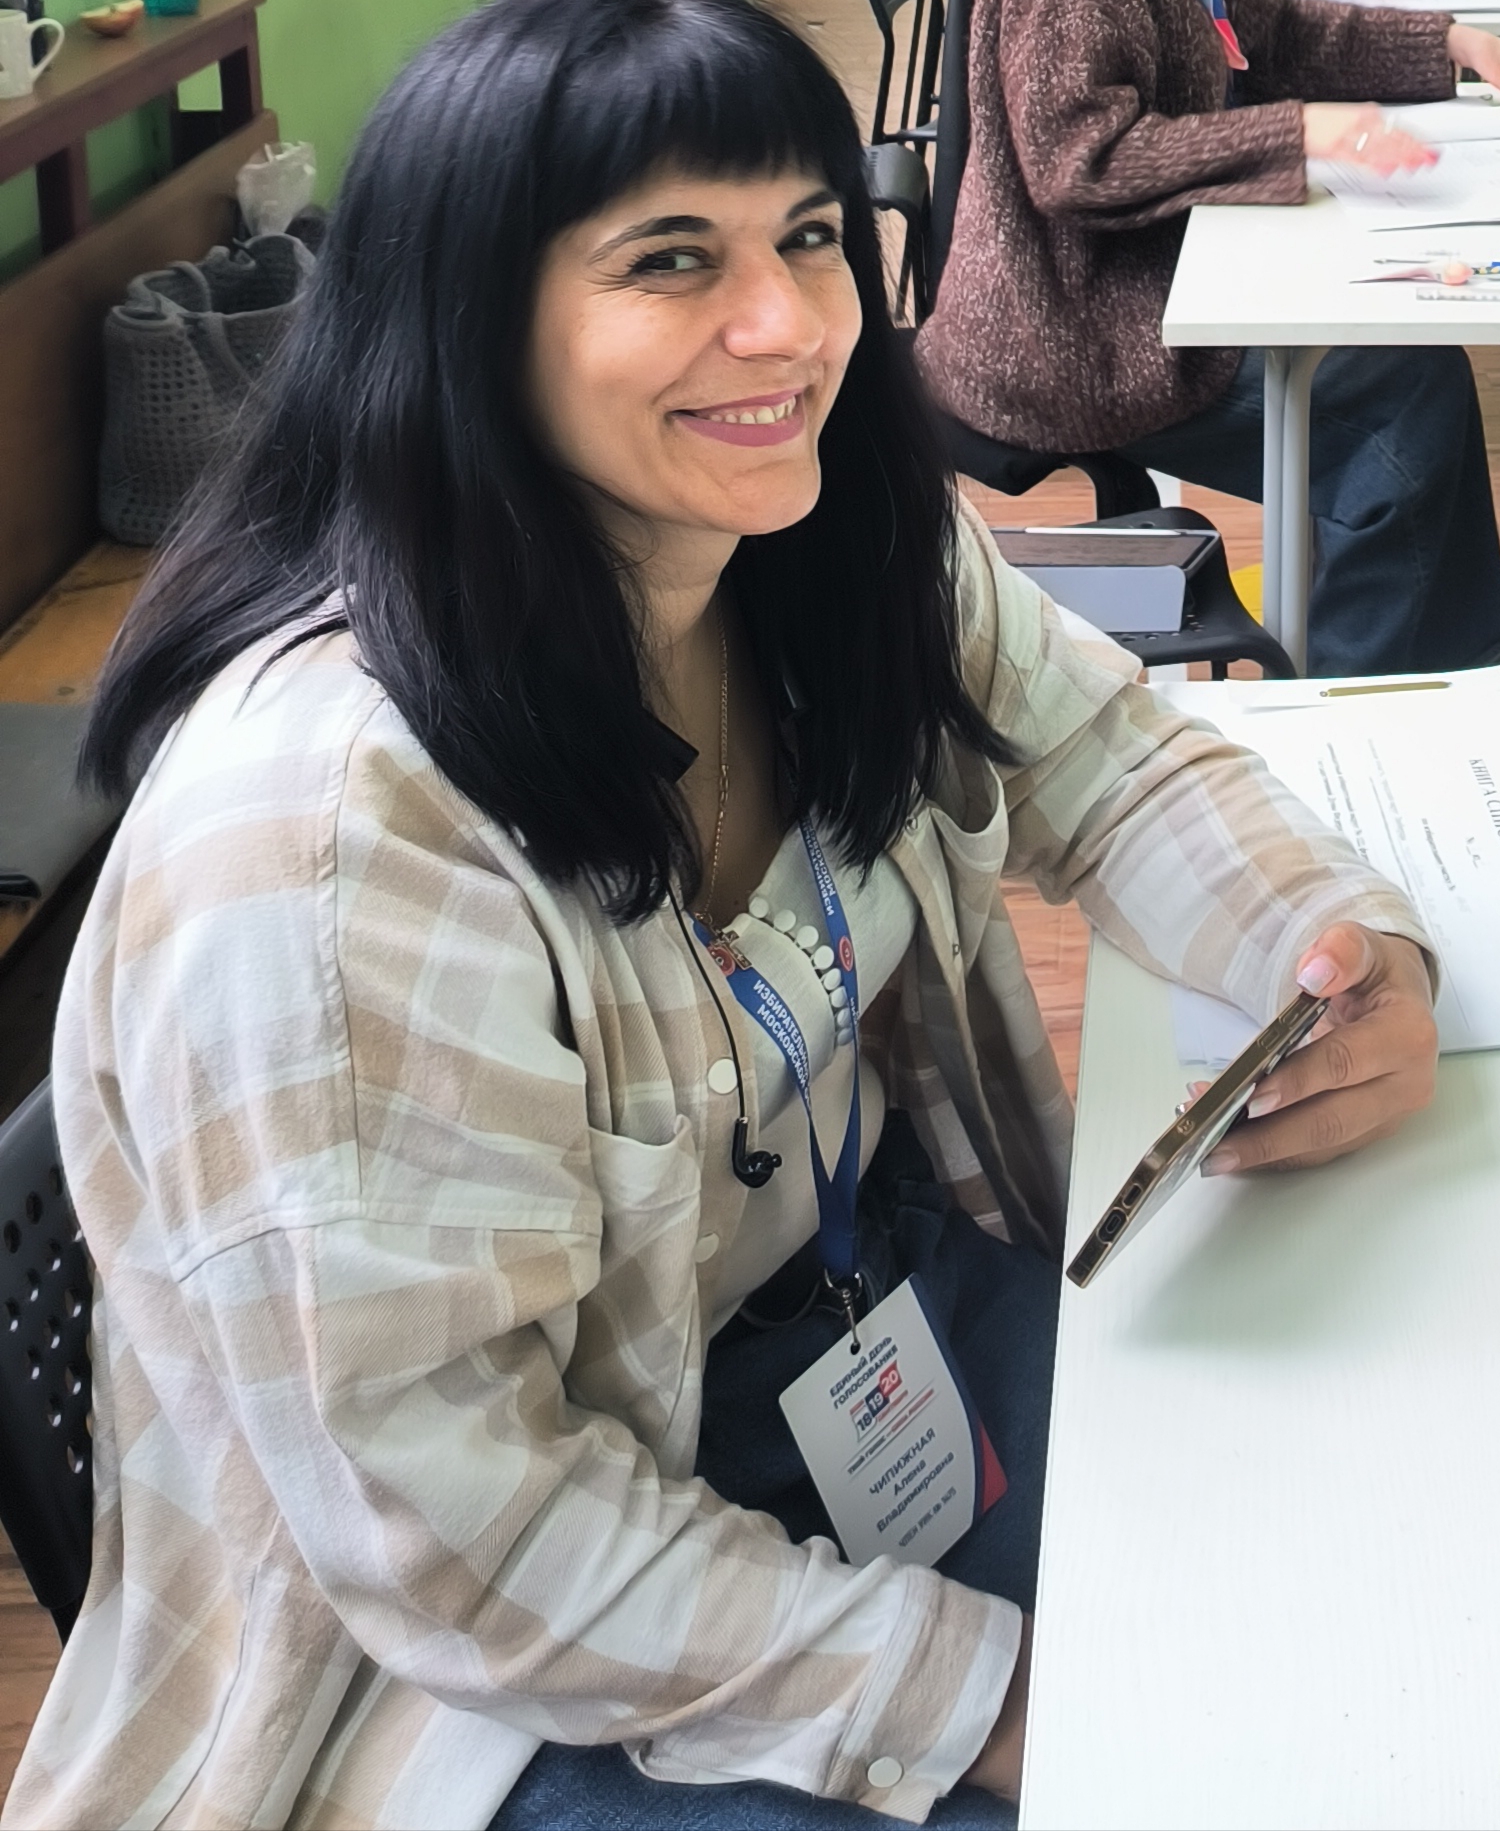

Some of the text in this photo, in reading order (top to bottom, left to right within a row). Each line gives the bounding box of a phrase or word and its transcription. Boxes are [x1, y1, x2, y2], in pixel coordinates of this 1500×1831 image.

[1469, 758, 1497, 796] КНИГА
[829, 1356, 867, 1398] ЕДИНЫЙ
[833, 1344, 898, 1410] ГОЛОСОВАНИЯ
[868, 1392, 884, 1411] 19
[881, 1370, 898, 1389] 20
[869, 1427, 936, 1496] ЧИПИЖНАЯ
